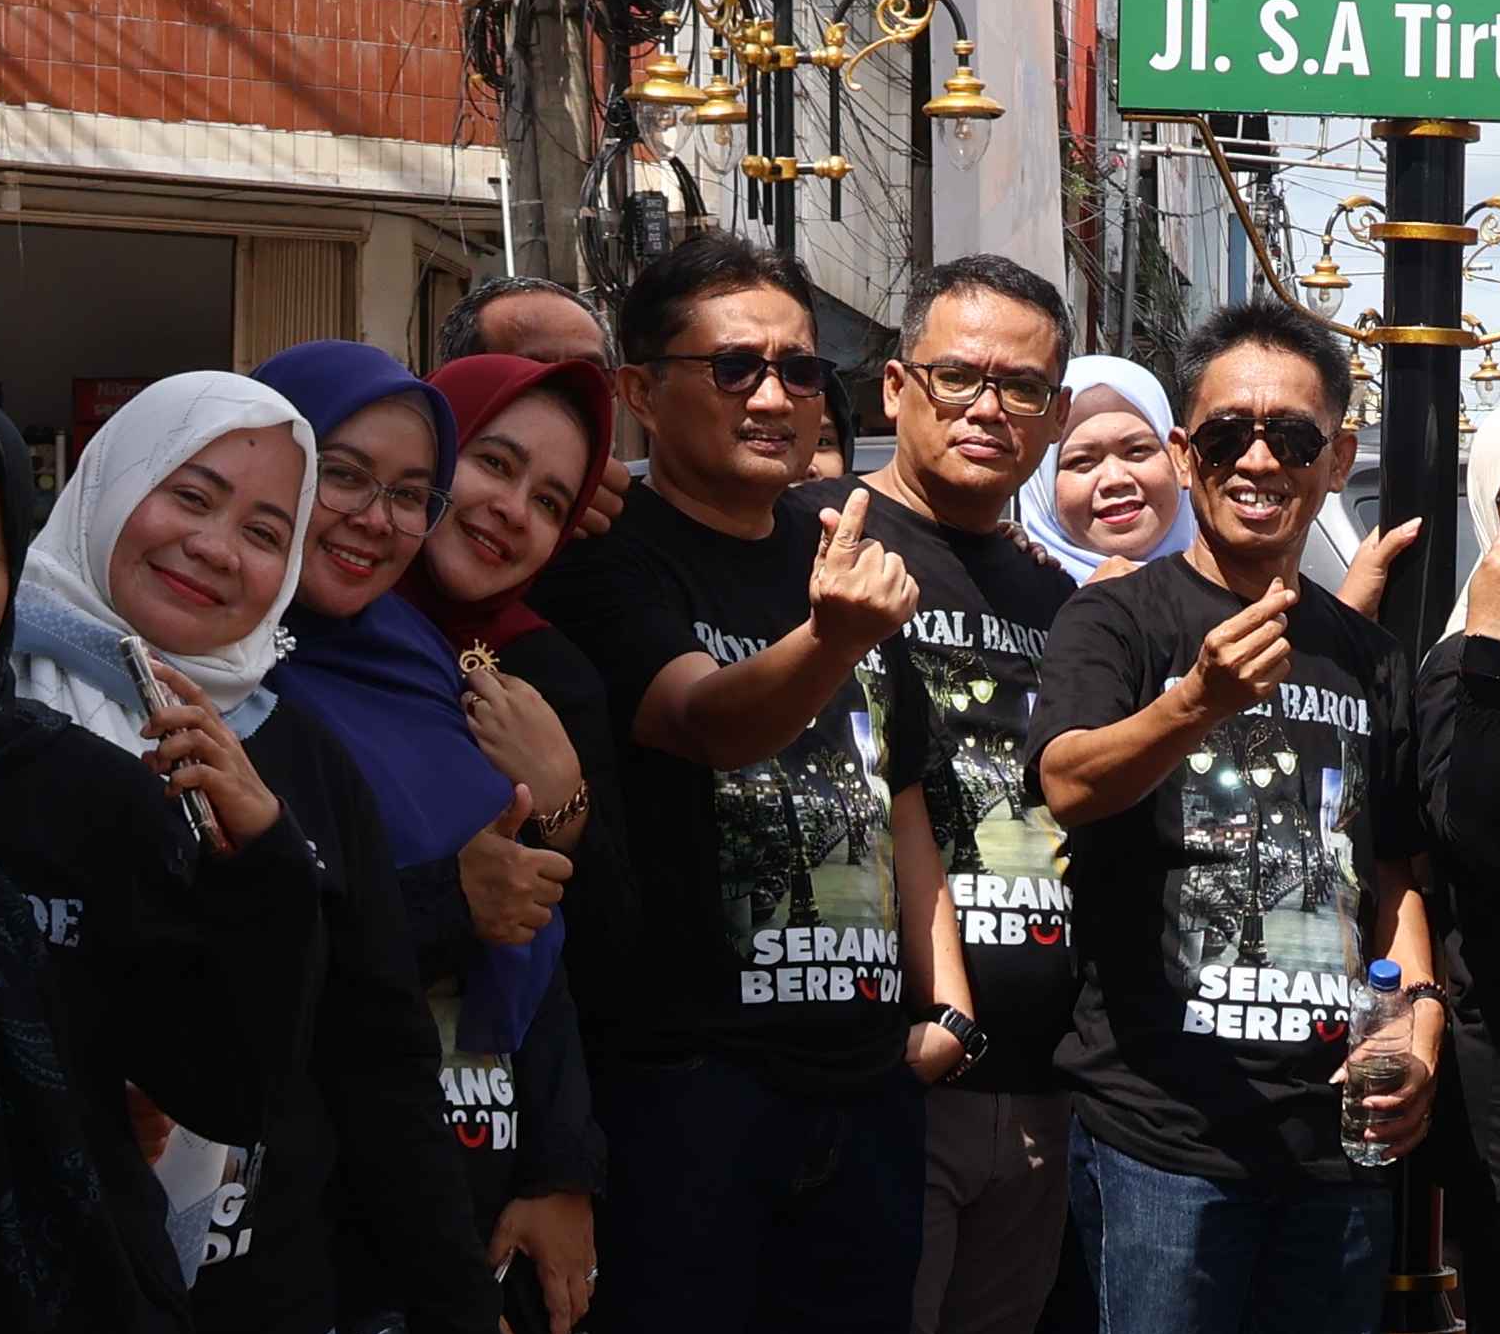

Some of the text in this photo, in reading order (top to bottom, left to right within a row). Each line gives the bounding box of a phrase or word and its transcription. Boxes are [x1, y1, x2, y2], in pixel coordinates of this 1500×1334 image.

[903, 610, 1049, 664] YAL BARO
[752, 927, 900, 967] SERANG
